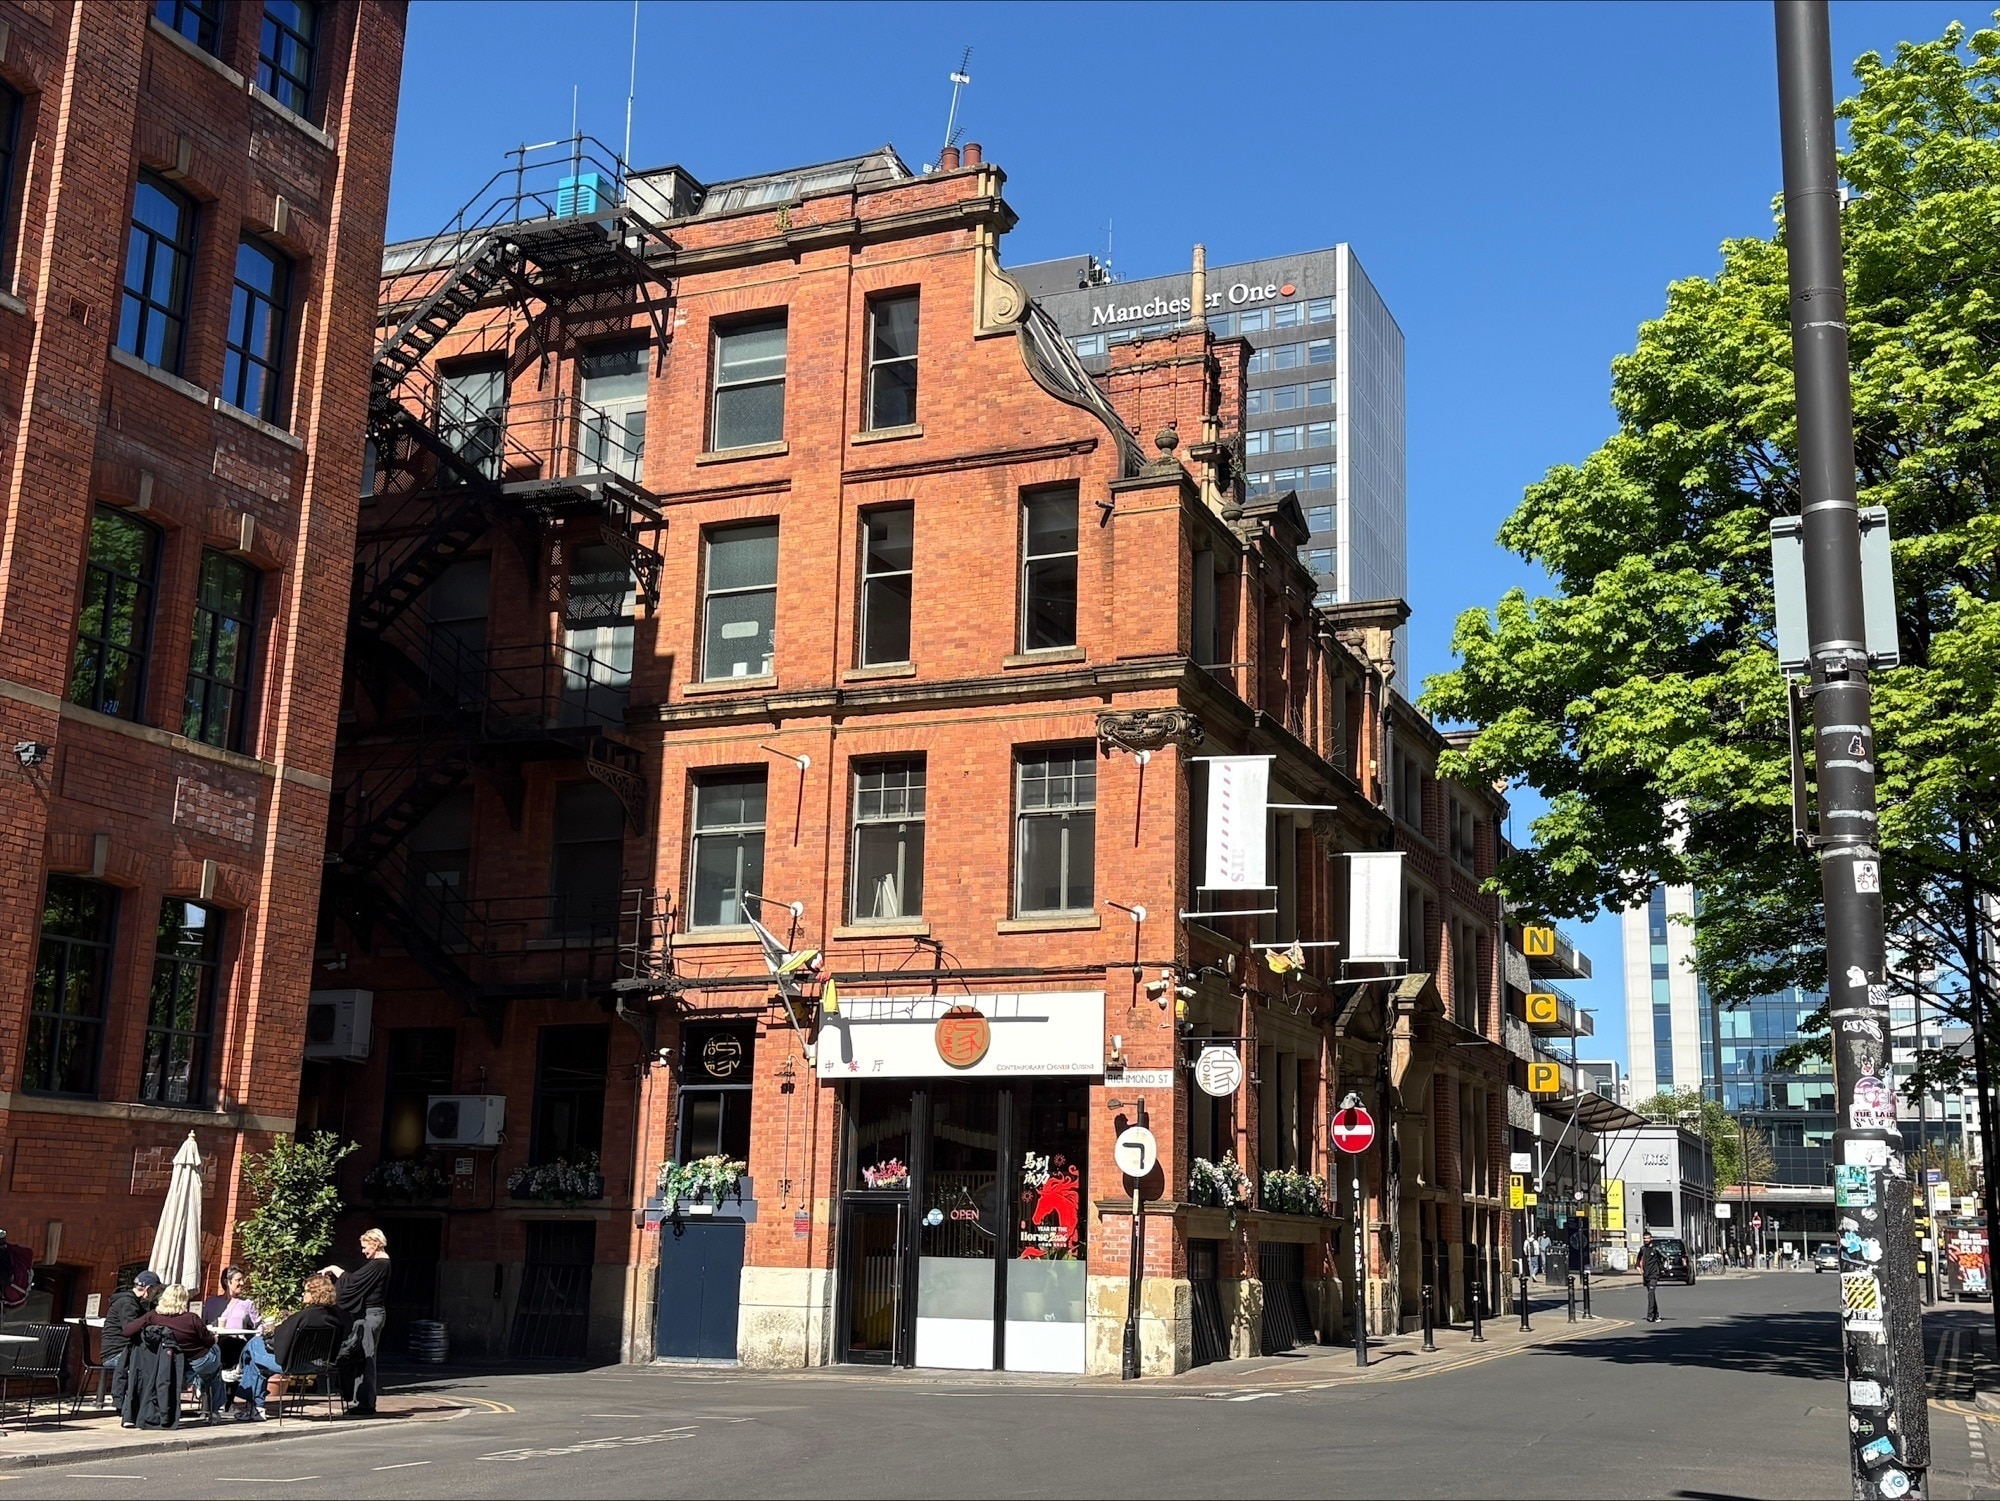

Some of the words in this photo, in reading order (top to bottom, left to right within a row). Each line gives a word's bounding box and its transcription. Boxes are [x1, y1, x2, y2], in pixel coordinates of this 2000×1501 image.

[1091, 292, 1222, 327] Mancheser
[1228, 283, 1277, 305] One
[1529, 929, 1548, 952] N
[1531, 996, 1551, 1019] C
[1107, 1074, 1155, 1084] RICHMOND
[1158, 1074, 1169, 1084] ST
[1202, 1056, 1211, 1088] HOME
[1534, 1066, 1552, 1089] P
[950, 1209, 980, 1220] OPEN
[1020, 1231, 1049, 1241] Horse
[1048, 1231, 1068, 1242] 2026
